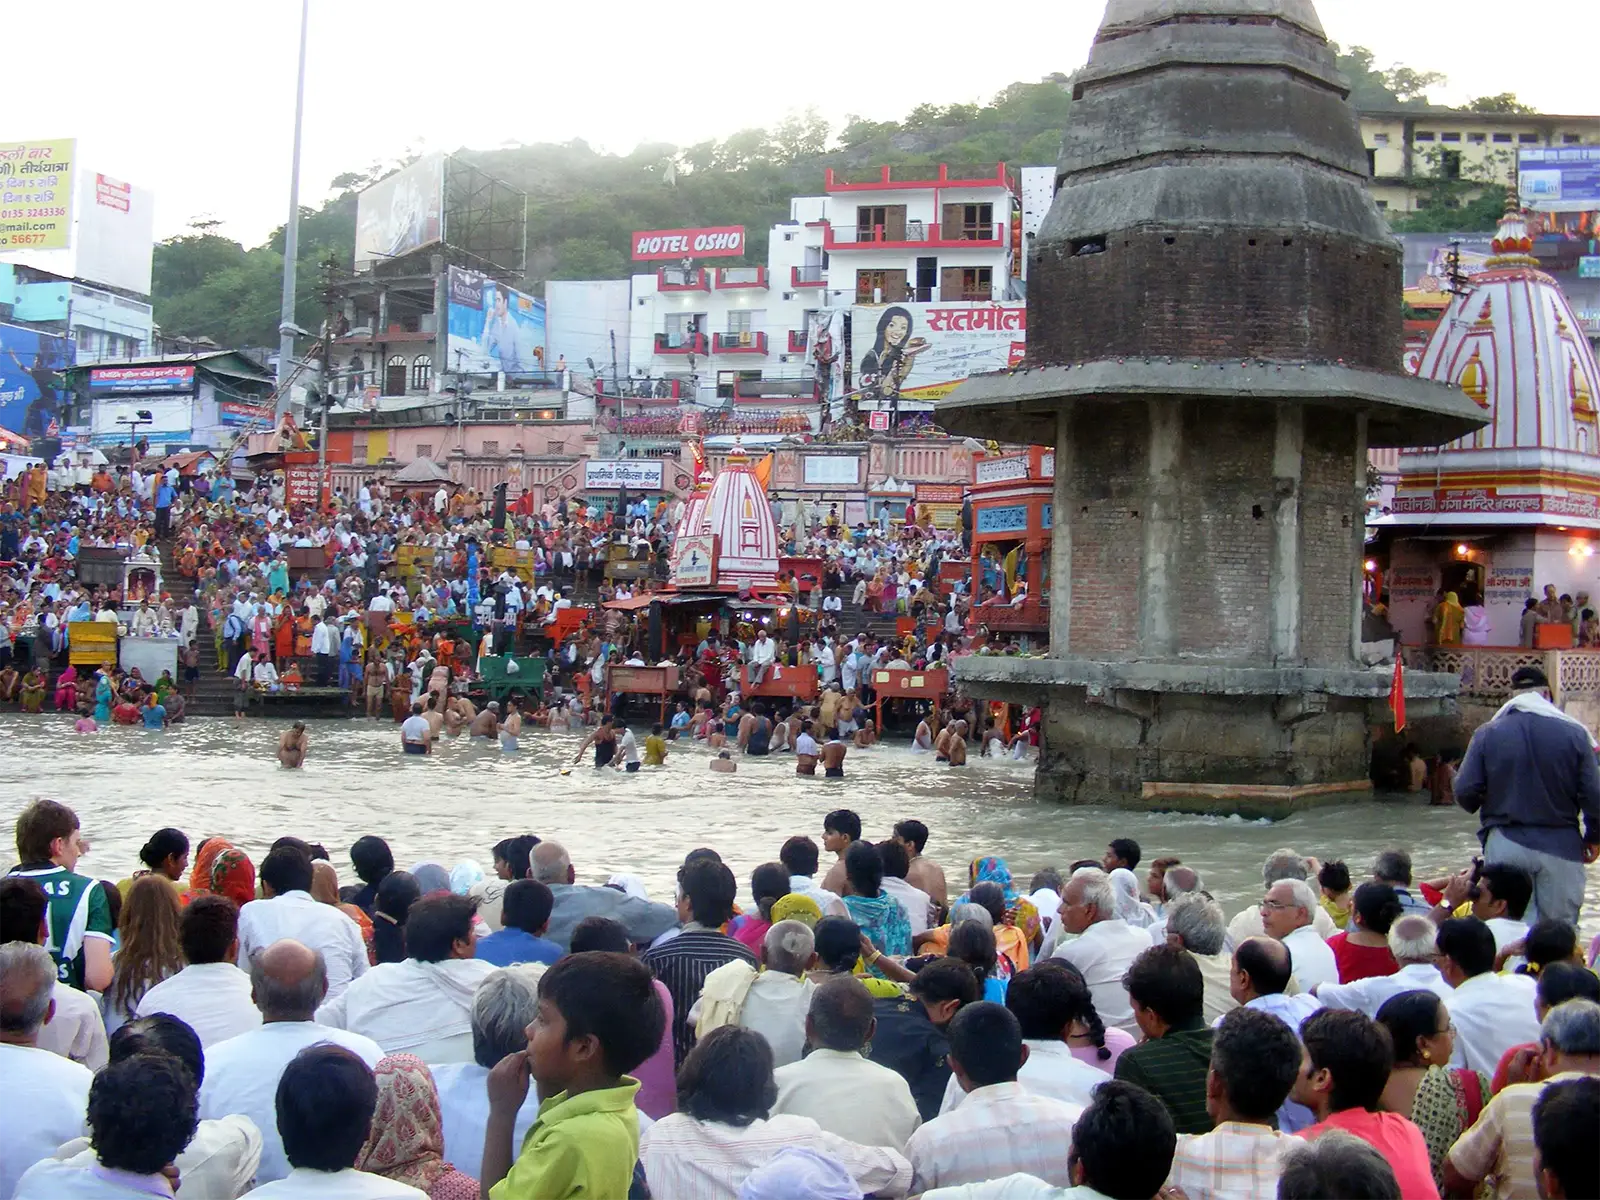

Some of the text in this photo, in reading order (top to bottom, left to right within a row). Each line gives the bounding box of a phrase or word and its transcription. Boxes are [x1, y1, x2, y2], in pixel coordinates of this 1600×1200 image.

[20, 161, 69, 174] तीर्थयात्रा
[38, 175, 58, 188] रात्रि
[1, 210, 23, 219] 0135
[11, 234, 46, 244] 56677
[637, 232, 740, 254] HOTEL OSHO
[587, 467, 614, 480] प्राथमिक
[615, 467, 643, 480] चिकित्सा
[1393, 497, 1423, 511] प्राचीन
[1440, 496, 1461, 510] गंगा
[1463, 495, 1494, 511] मन्दिर
